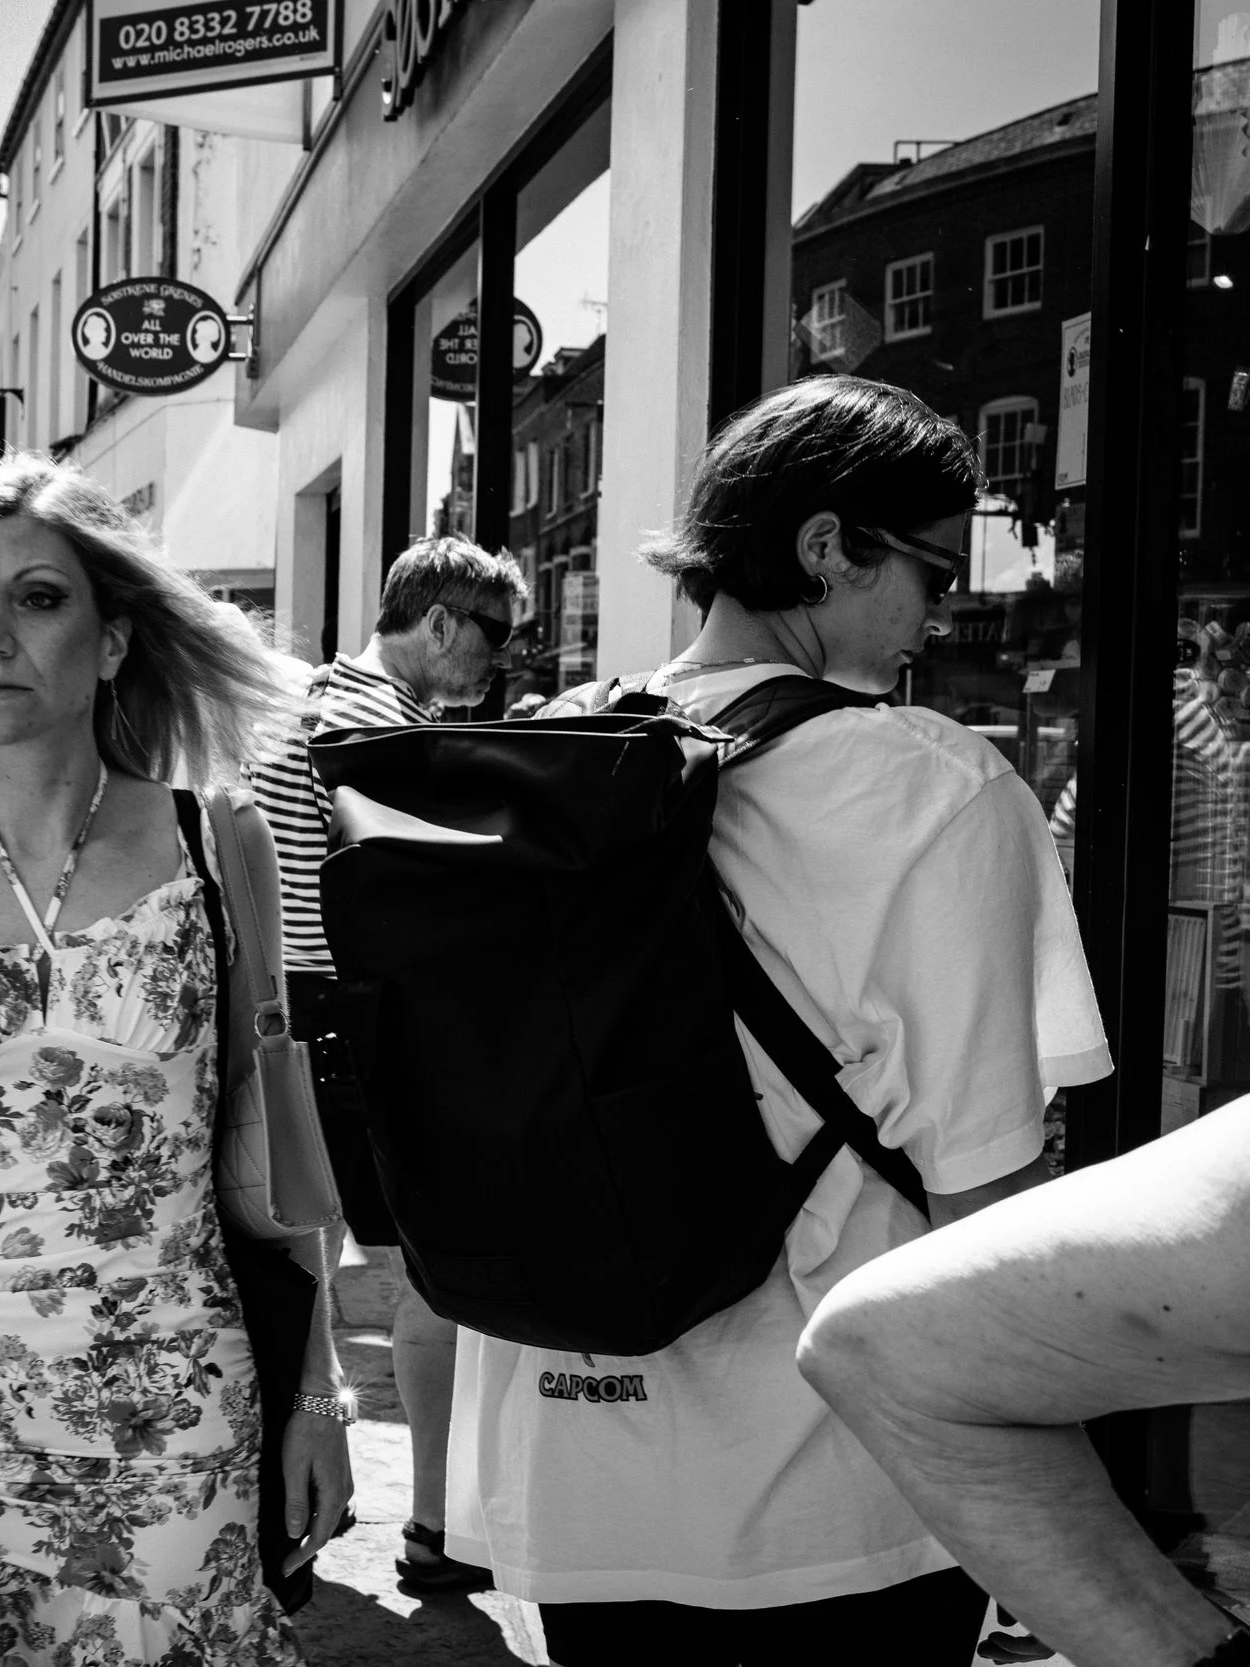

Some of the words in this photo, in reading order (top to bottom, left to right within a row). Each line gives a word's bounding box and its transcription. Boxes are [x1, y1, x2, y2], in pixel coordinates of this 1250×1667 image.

[119, 20, 167, 50] 020
[173, 10, 238, 42] 8332
[245, 0, 313, 32] 7788
[111, 25, 320, 70] www.michaelrogers.co.uk
[142, 319, 162, 331] ALL
[121, 332, 154, 345] OVER
[159, 333, 180, 346] THE
[129, 348, 173, 360] WORLD
[96, 360, 204, 387] HANDELSKOMPAGNIE
[538, 1371, 648, 1403] CAPCOM
